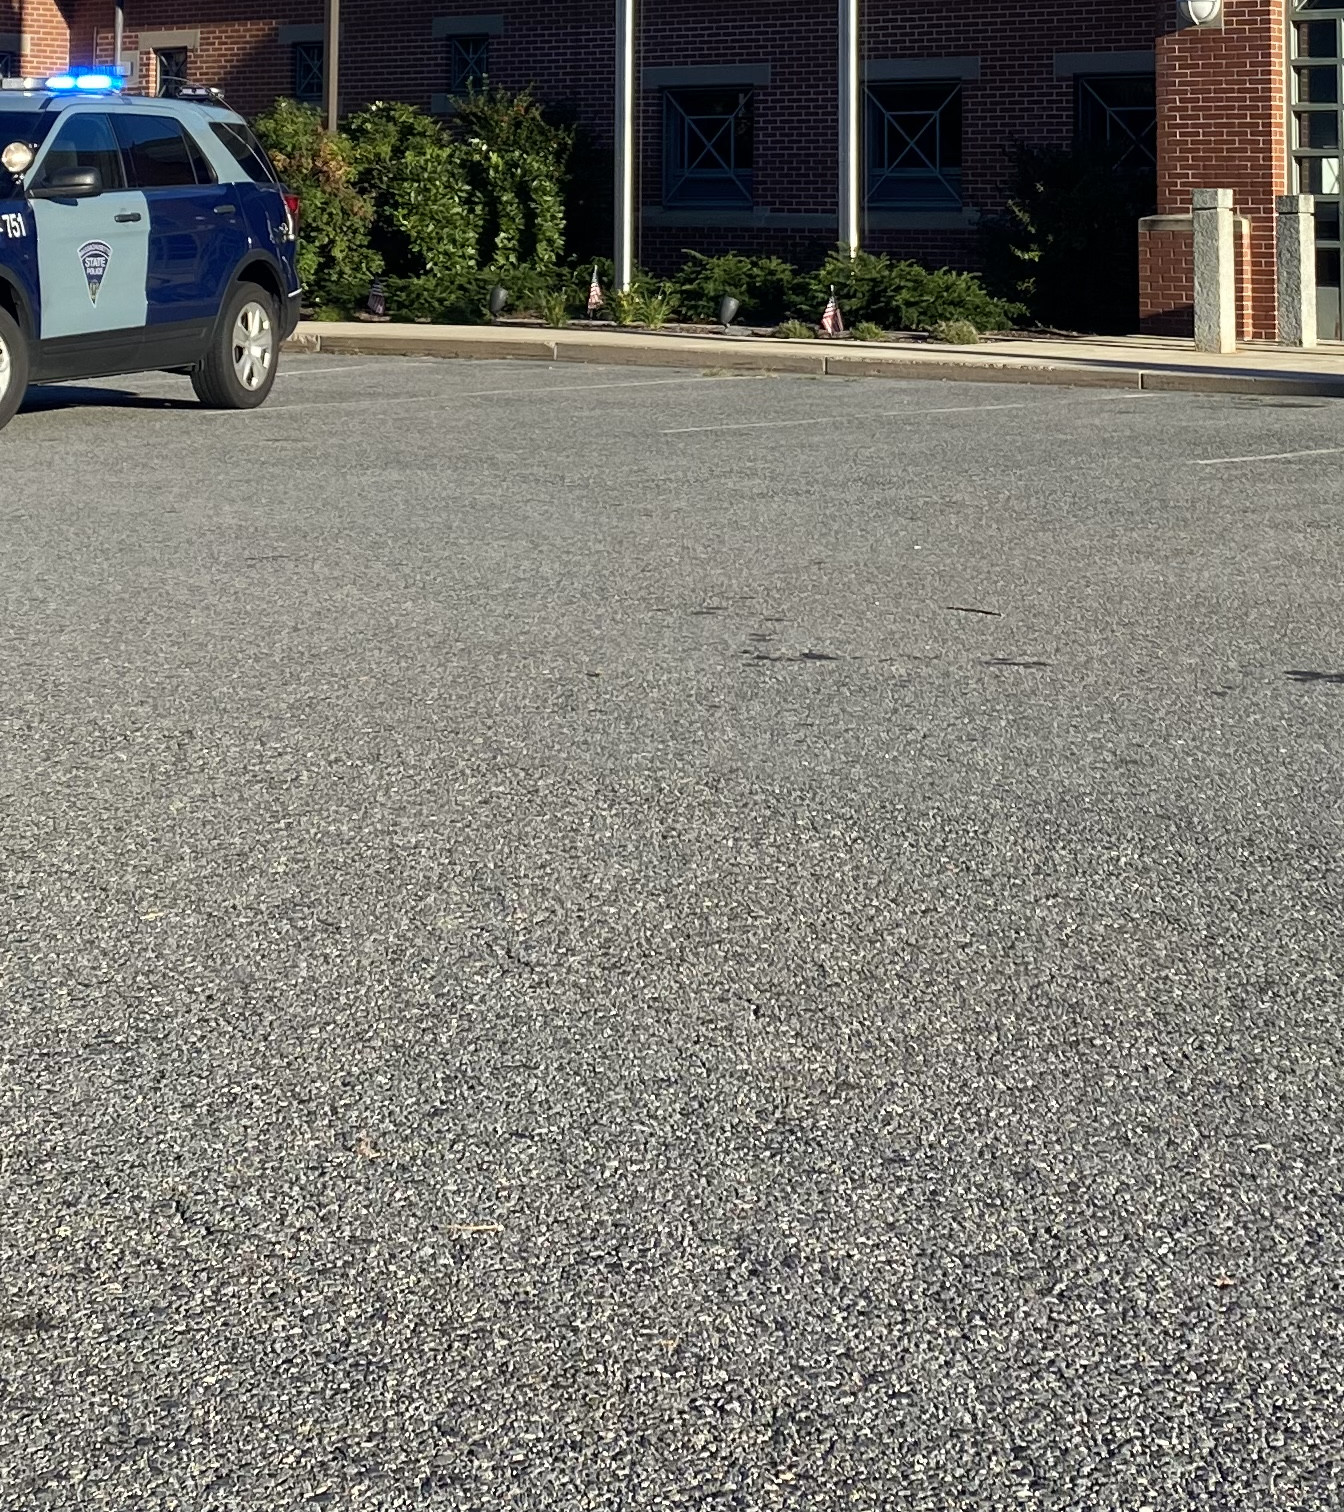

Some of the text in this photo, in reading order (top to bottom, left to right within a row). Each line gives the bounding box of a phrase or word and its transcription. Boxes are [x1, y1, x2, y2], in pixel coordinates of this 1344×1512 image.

[1, 212, 26, 239] 751
[84, 256, 106, 268] STATE
[86, 267, 103, 275] POLICE
